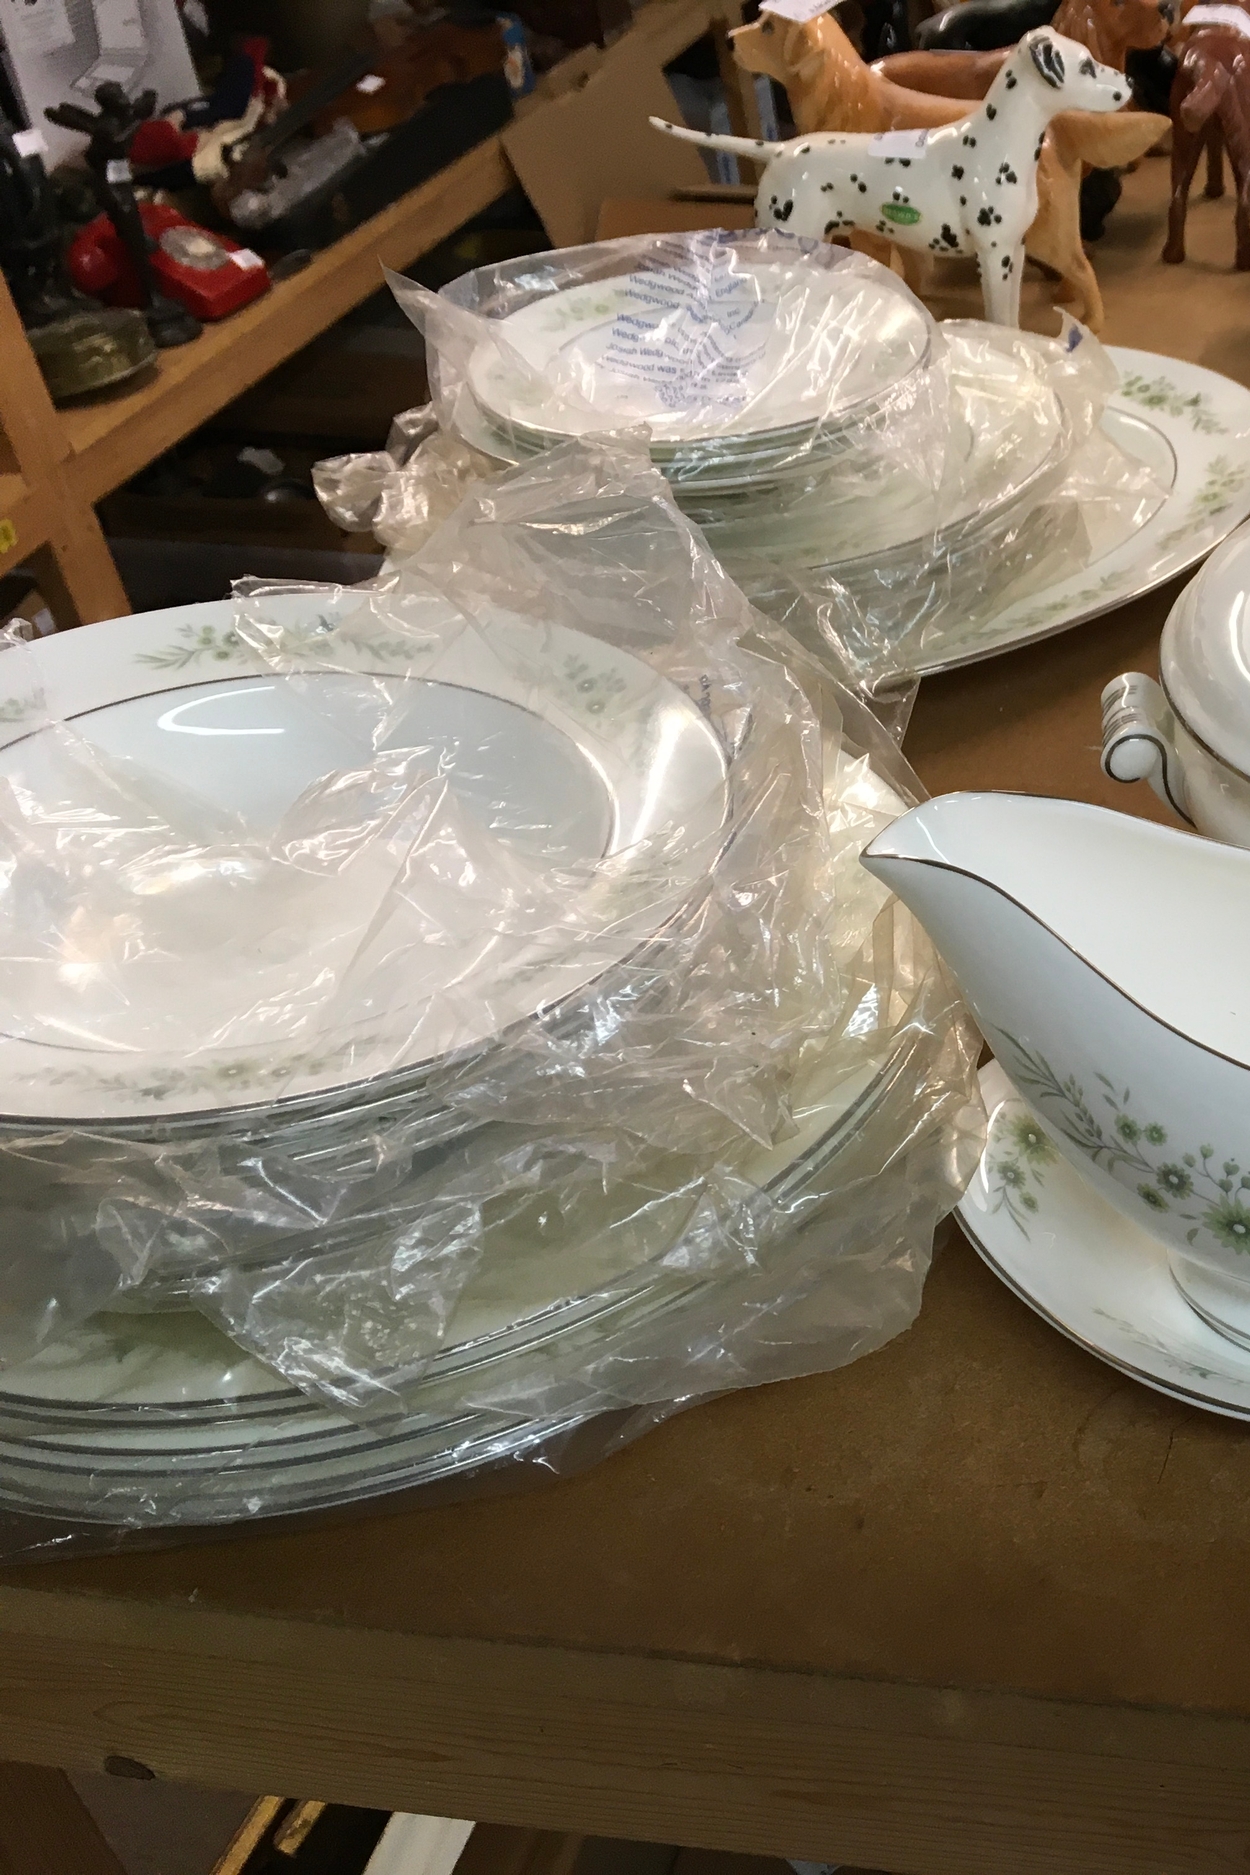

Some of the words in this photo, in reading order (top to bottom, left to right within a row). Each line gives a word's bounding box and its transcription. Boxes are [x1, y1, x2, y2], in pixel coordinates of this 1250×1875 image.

[629, 274, 684, 295] Wedgwood
[625, 289, 680, 309] Wedgwood
[657, 364, 677, 375] was
